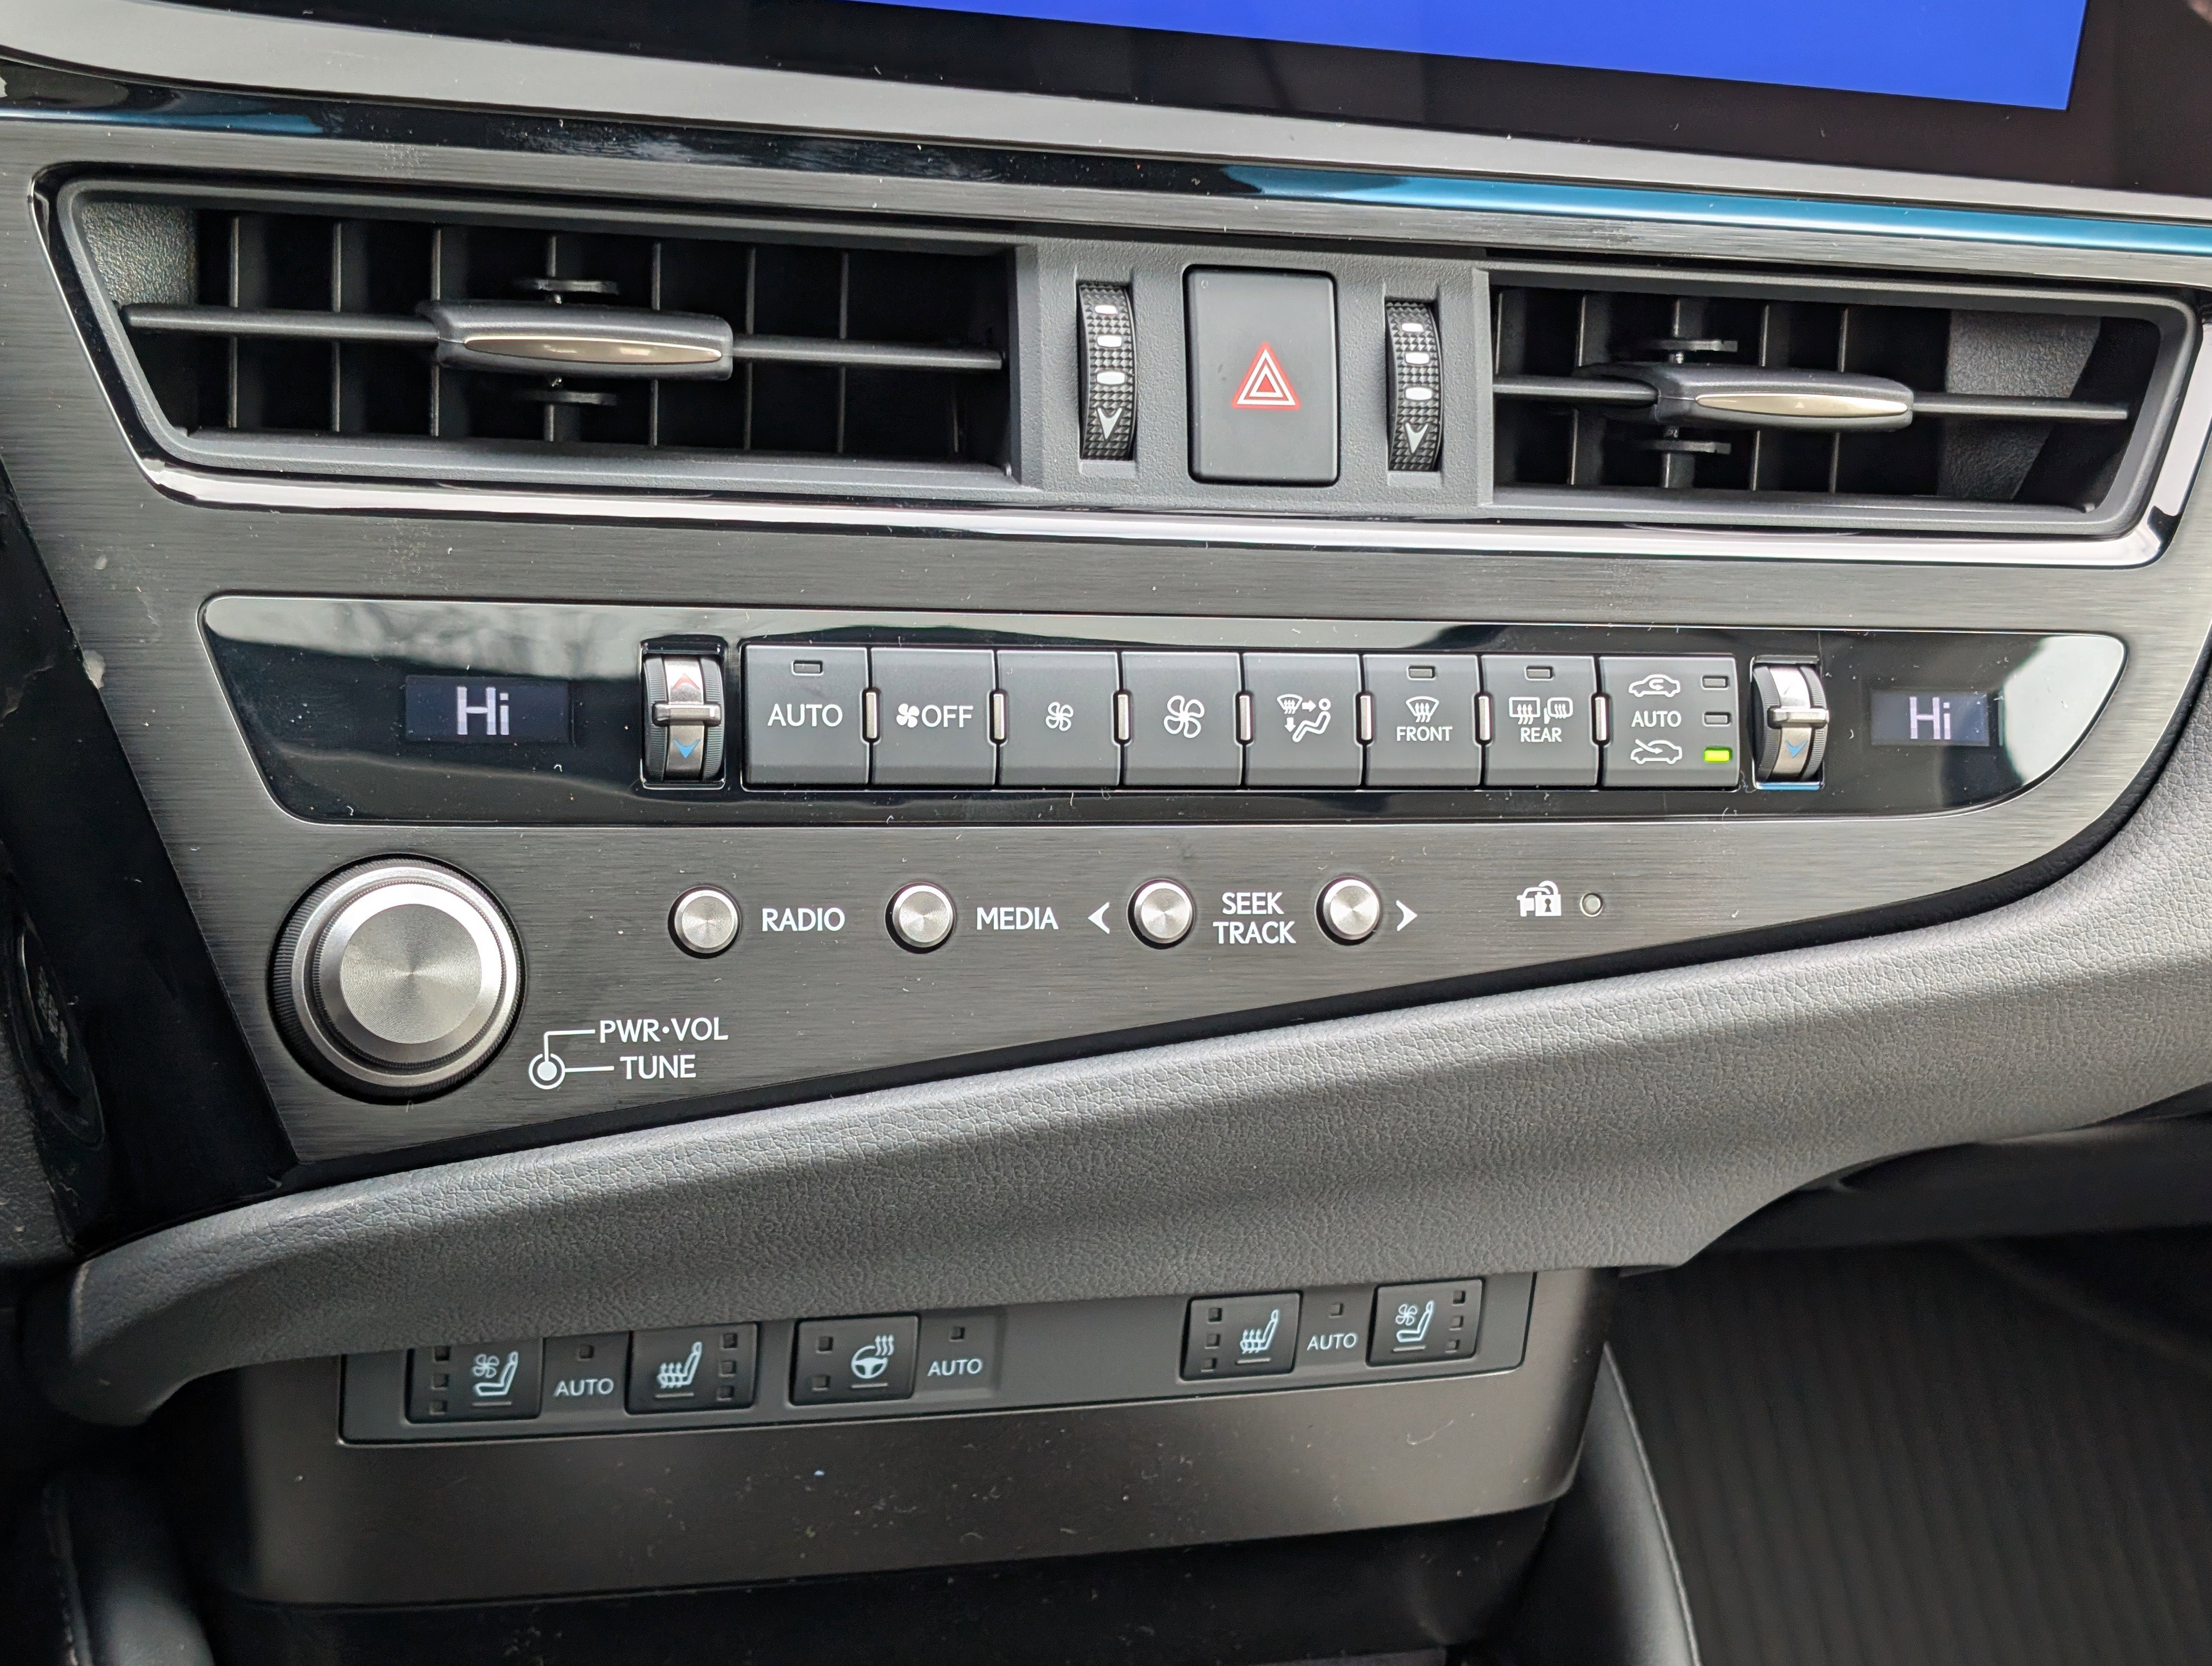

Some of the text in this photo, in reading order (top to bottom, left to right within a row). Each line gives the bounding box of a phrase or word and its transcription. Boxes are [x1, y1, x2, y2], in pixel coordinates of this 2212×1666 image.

[456, 686, 510, 735] Hi
[767, 703, 843, 727] AUTO
[921, 704, 974, 728] OFF
[1631, 710, 1682, 728] AUTO
[1909, 696, 1951, 740] Hi
[1397, 726, 1453, 742] FRONT
[1520, 727, 1562, 742] REAR
[1222, 892, 1284, 915] SEEK
[762, 907, 846, 932] RADIO
[976, 907, 1059, 930] MEDIA
[1212, 921, 1296, 944] TRACK
[620, 1054, 697, 1080] TUNE
[1307, 1333, 1358, 1351] AUTO
[927, 1359, 983, 1377] AUTO
[554, 1378, 614, 1397] AUTO
